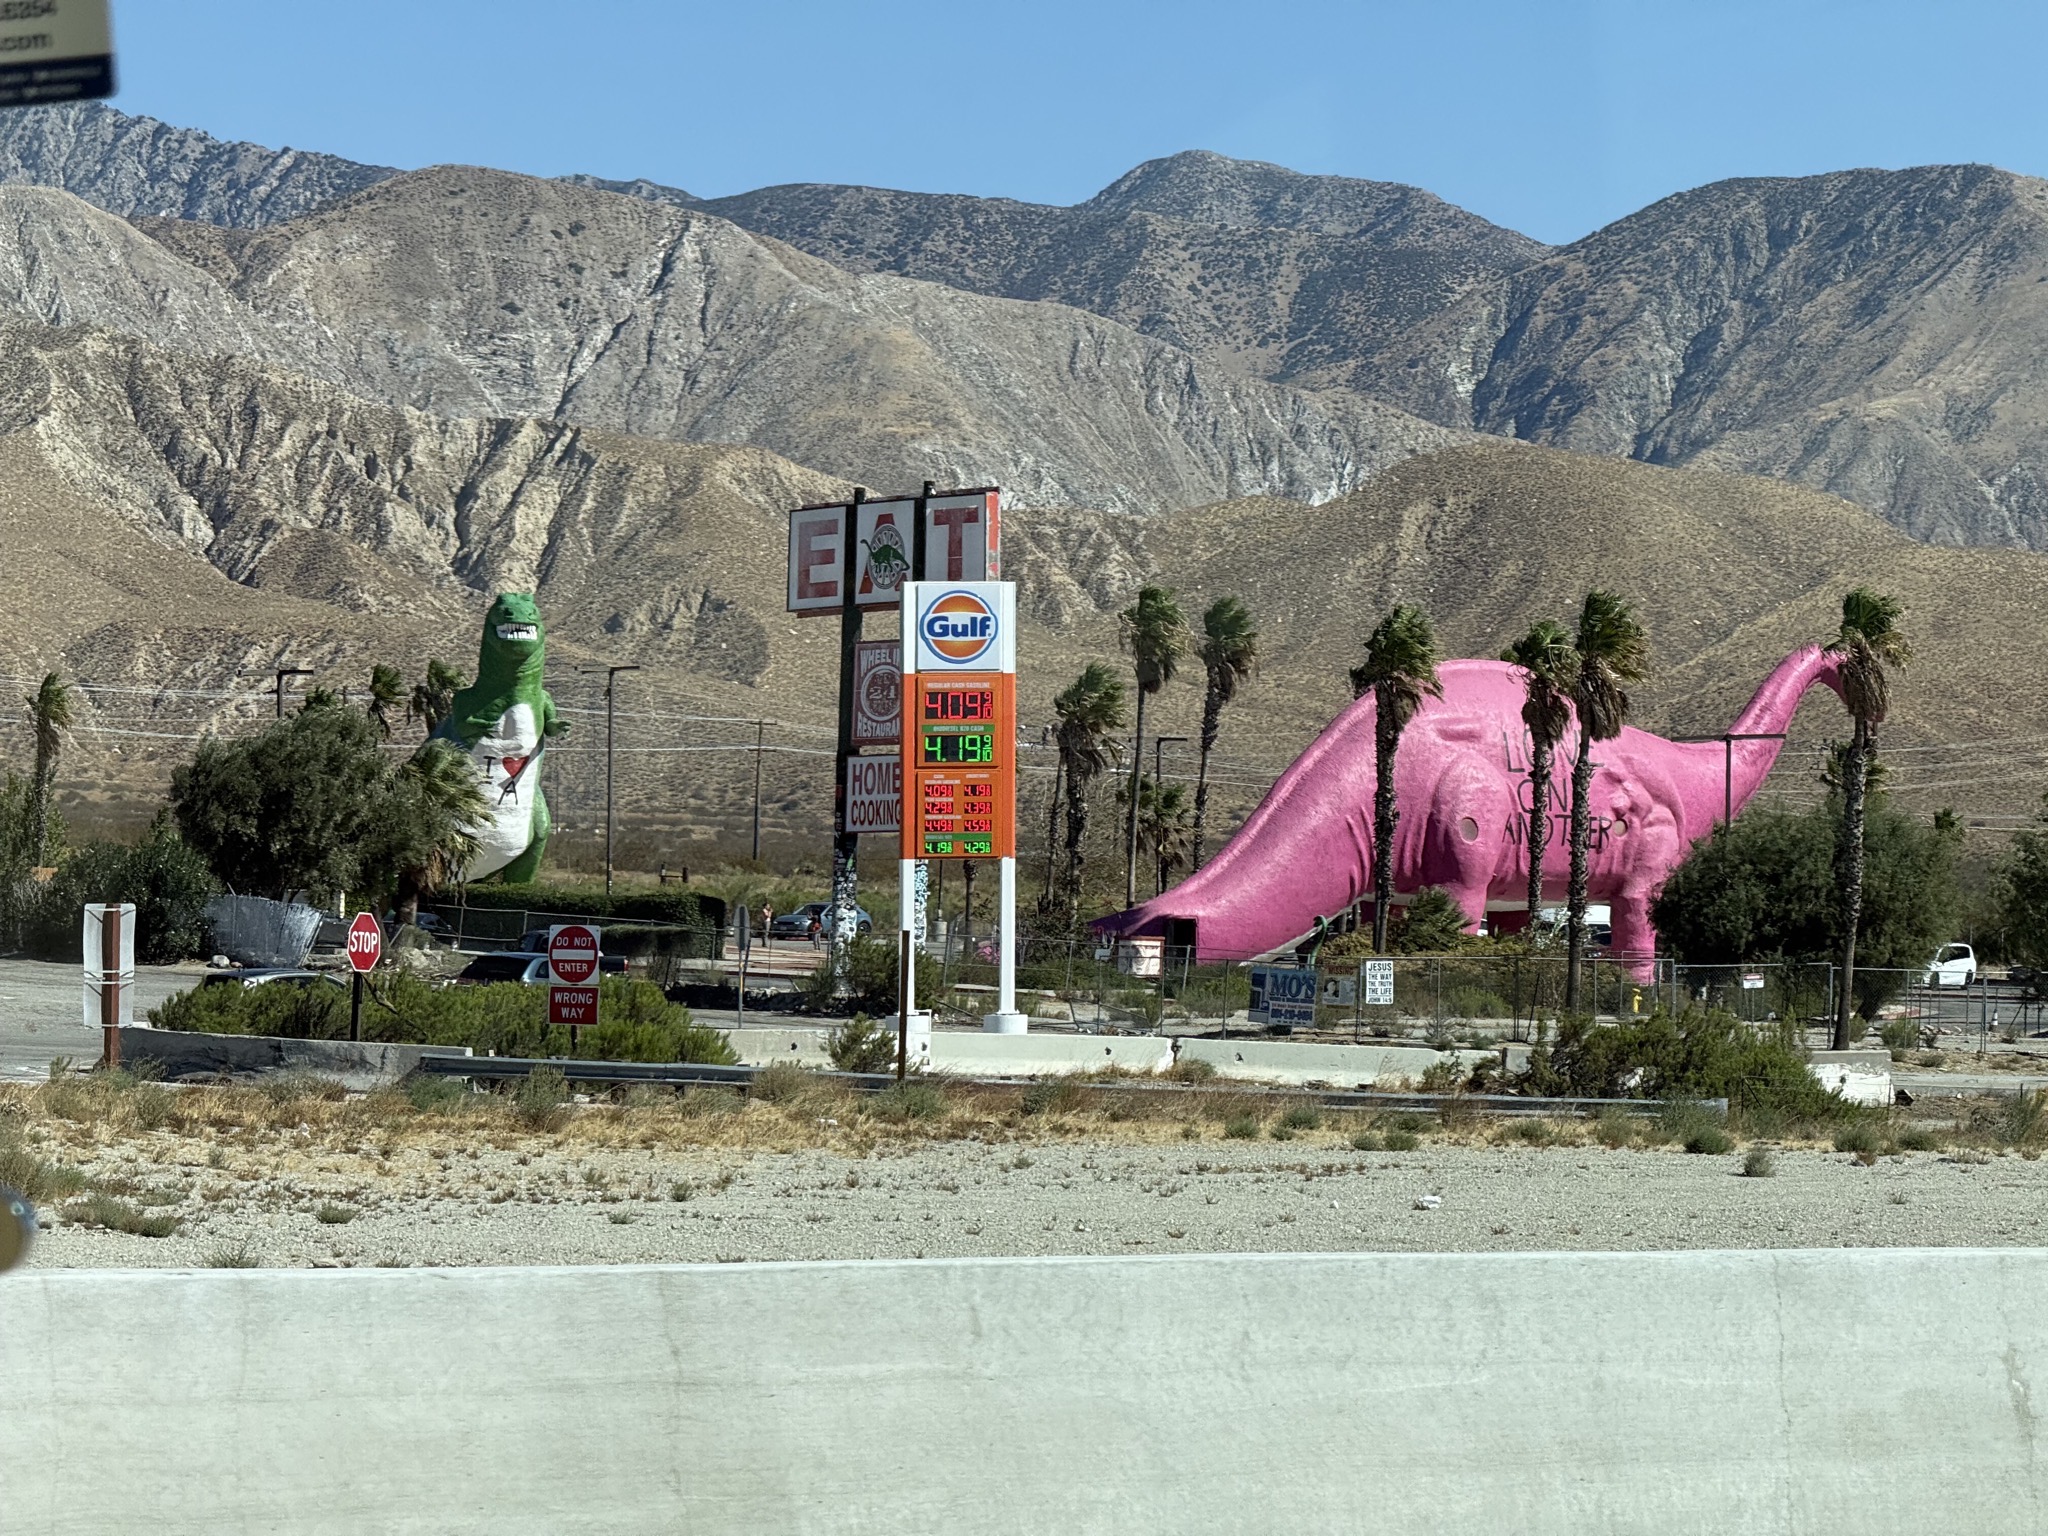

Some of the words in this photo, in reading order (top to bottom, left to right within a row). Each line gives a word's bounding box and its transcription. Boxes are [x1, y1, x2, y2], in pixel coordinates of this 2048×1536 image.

[926, 615, 992, 638] Gulf
[860, 648, 891, 678] WHEEL
[869, 685, 896, 700] 24
[925, 692, 980, 719] 4.09
[925, 735, 980, 762] 4.19
[1503, 727, 1605, 773] LOV
[852, 762, 900, 796] HOME
[925, 785, 947, 796] 4.09
[964, 785, 986, 796] 4.19
[1517, 778, 1591, 815] ON
[925, 802, 947, 813] 4.29
[964, 802, 986, 813] 4.39
[925, 820, 947, 831] 4.49
[964, 820, 986, 831] 4.59
[925, 842, 947, 853] 4.19
[964, 842, 986, 853] 4.29
[350, 931, 378, 953] STOP
[556, 937, 569, 946] DO
[574, 937, 592, 947] NOT
[559, 963, 588, 972] ENTER
[1368, 963, 1392, 971] JESUS
[1269, 973, 1316, 998] MO'S
[554, 993, 593, 1004] WRONG
[561, 1007, 585, 1019] WAY
